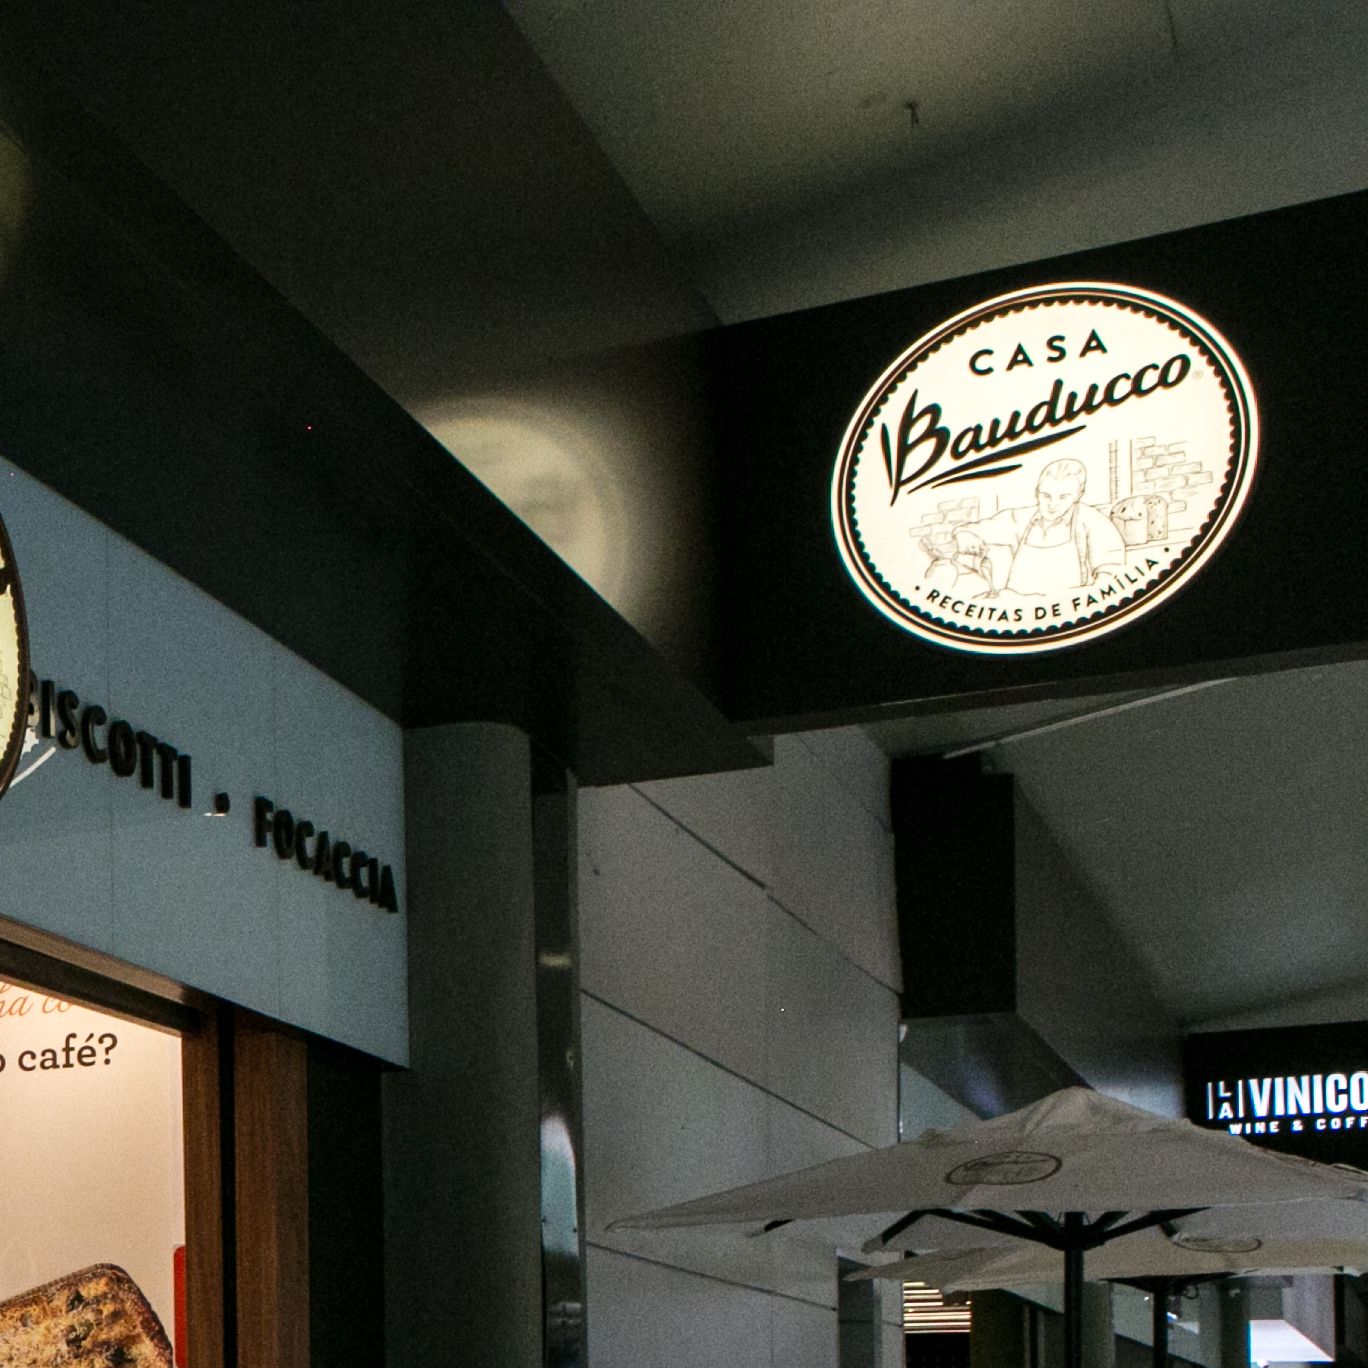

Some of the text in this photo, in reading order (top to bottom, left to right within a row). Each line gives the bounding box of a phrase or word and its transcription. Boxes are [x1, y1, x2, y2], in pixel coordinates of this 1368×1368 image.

[969, 329, 1108, 376] CASA
[881, 353, 1191, 507] Bauducco
[925, 556, 1160, 623] RECEITAS DE FAMÍLIA
[254, 796, 398, 912] FOCACCIA
[17, 1033, 119, 1073] café?
[1229, 1121, 1280, 1135] WINE
[1291, 1119, 1304, 1132] &
